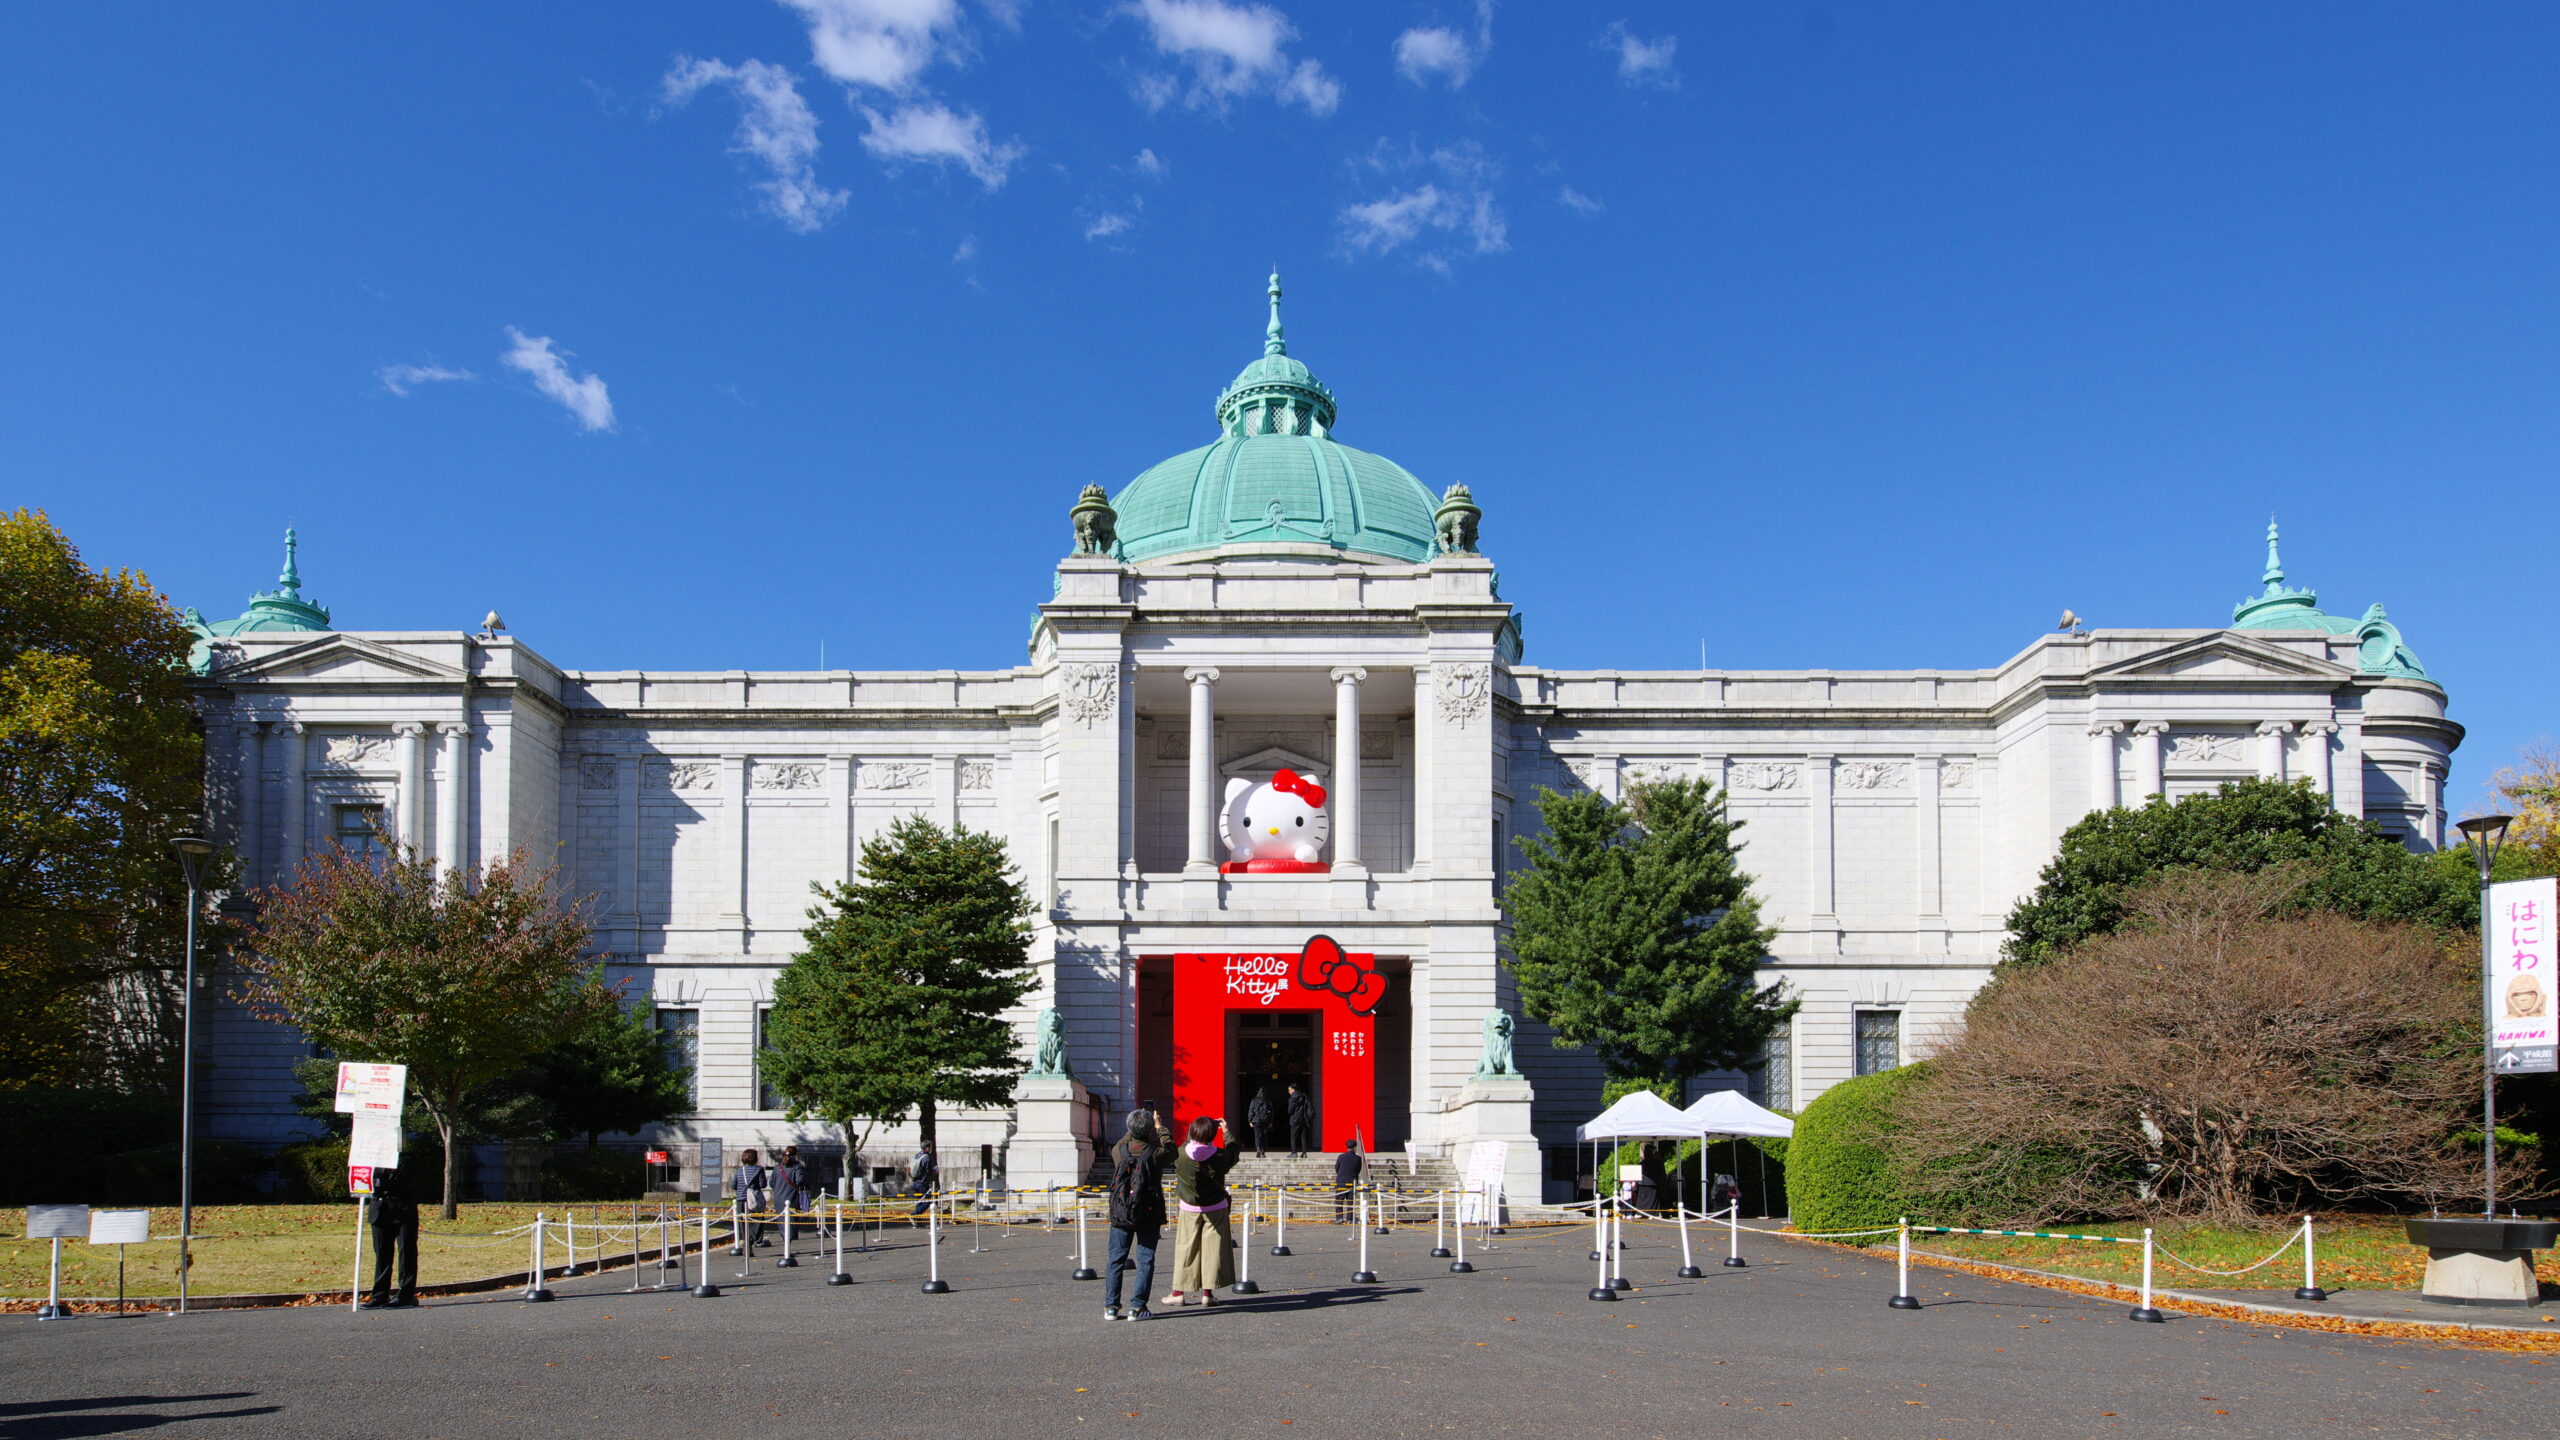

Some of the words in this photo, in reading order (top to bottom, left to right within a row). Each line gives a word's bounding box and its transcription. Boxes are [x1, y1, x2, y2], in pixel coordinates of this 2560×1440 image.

[2511, 900, 2538, 971] はにわ
[1223, 956, 1289, 976] Hello
[2497, 1030, 2546, 1041] HANIWA
